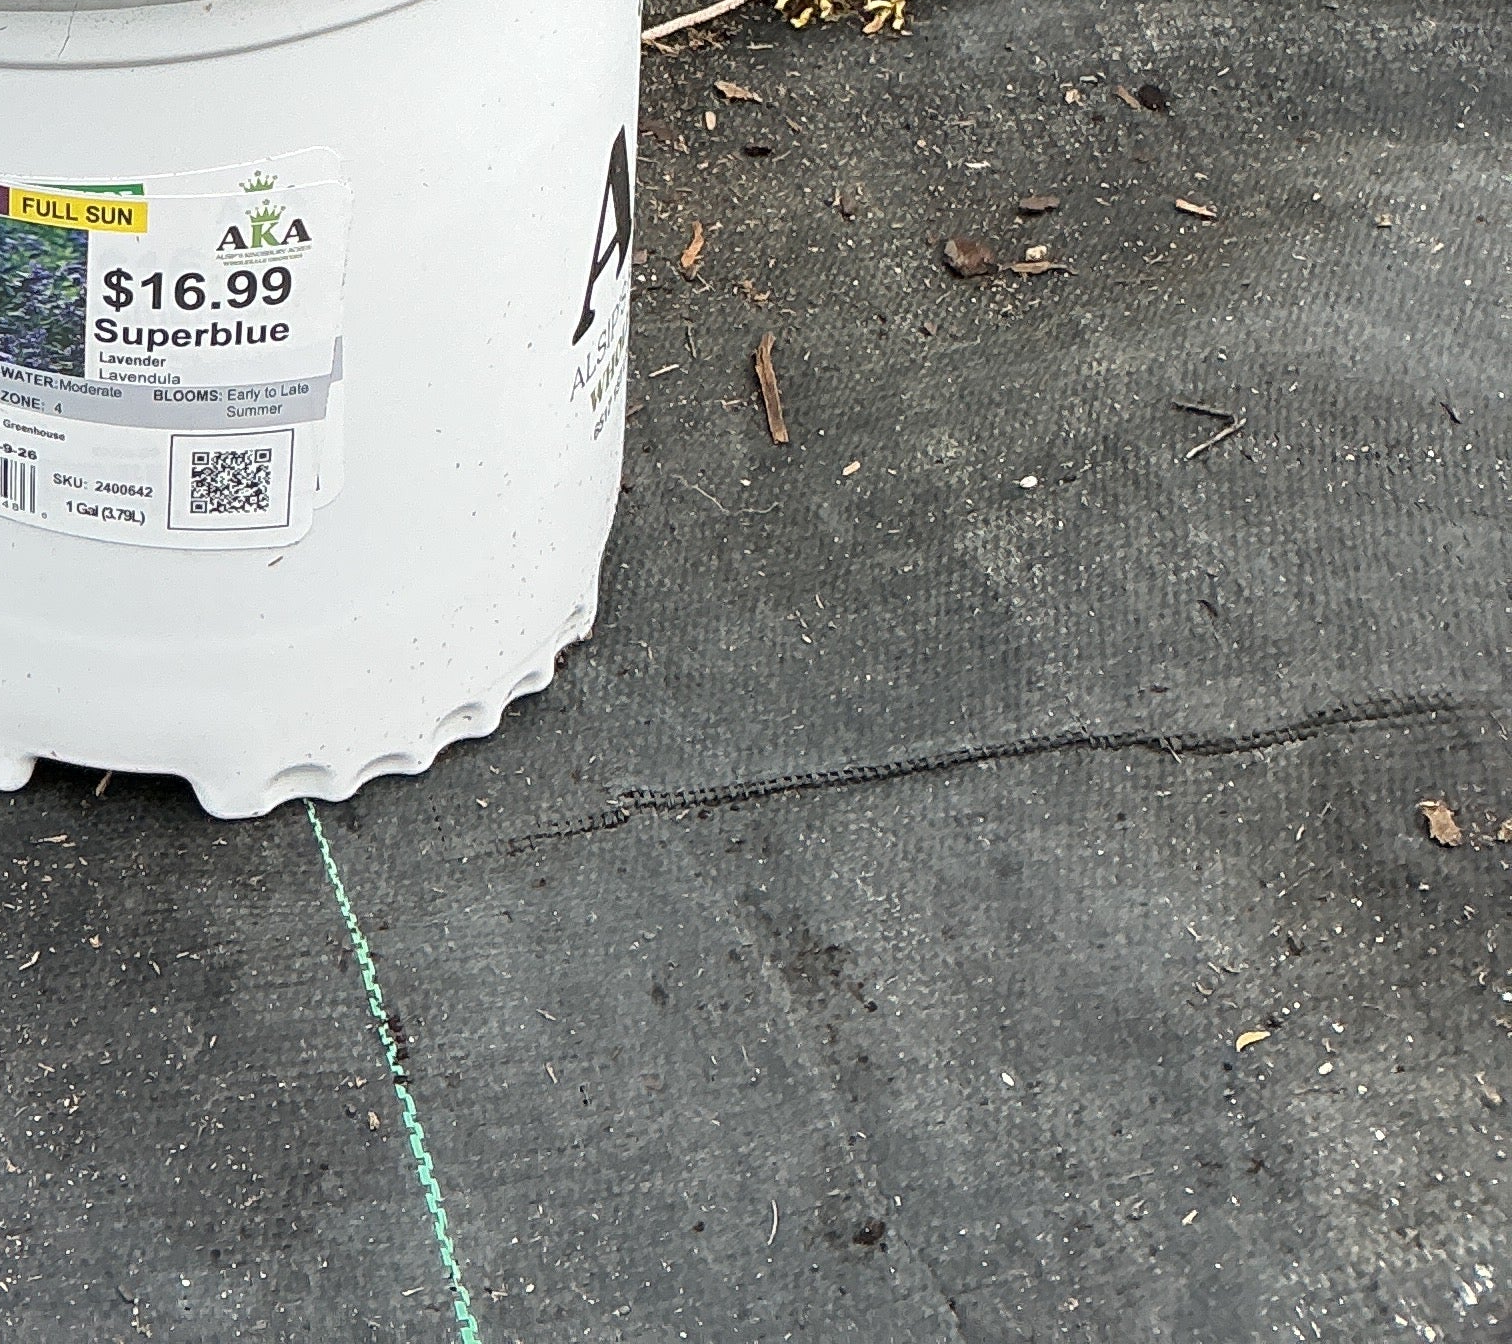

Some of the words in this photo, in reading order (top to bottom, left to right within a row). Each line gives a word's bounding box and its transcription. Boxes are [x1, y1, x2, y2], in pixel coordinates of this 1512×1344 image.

[22, 196, 78, 222] FULL
[85, 205, 133, 226] SUN
[215, 218, 313, 252] AKA
[102, 266, 293, 313] $16.99
[93, 317, 290, 353] Superblue
[99, 351, 167, 368] Lavender
[98, 368, 181, 385] Lavendula
[59, 379, 123, 399] Moderate
[153, 388, 223, 403] BLOOMS:
[227, 387, 262, 402] Early
[264, 387, 277, 398] to
[280, 382, 310, 397] Late
[0, 389, 45, 412] ZONE:
[53, 402, 63, 414] 4
[227, 404, 283, 419] Summer
[2, 418, 66, 442] Greenhouse
[52, 472, 89, 489] SKU:
[94, 480, 154, 499] 2400642
[66, 500, 74, 513] 1
[76, 502, 99, 518] Gal
